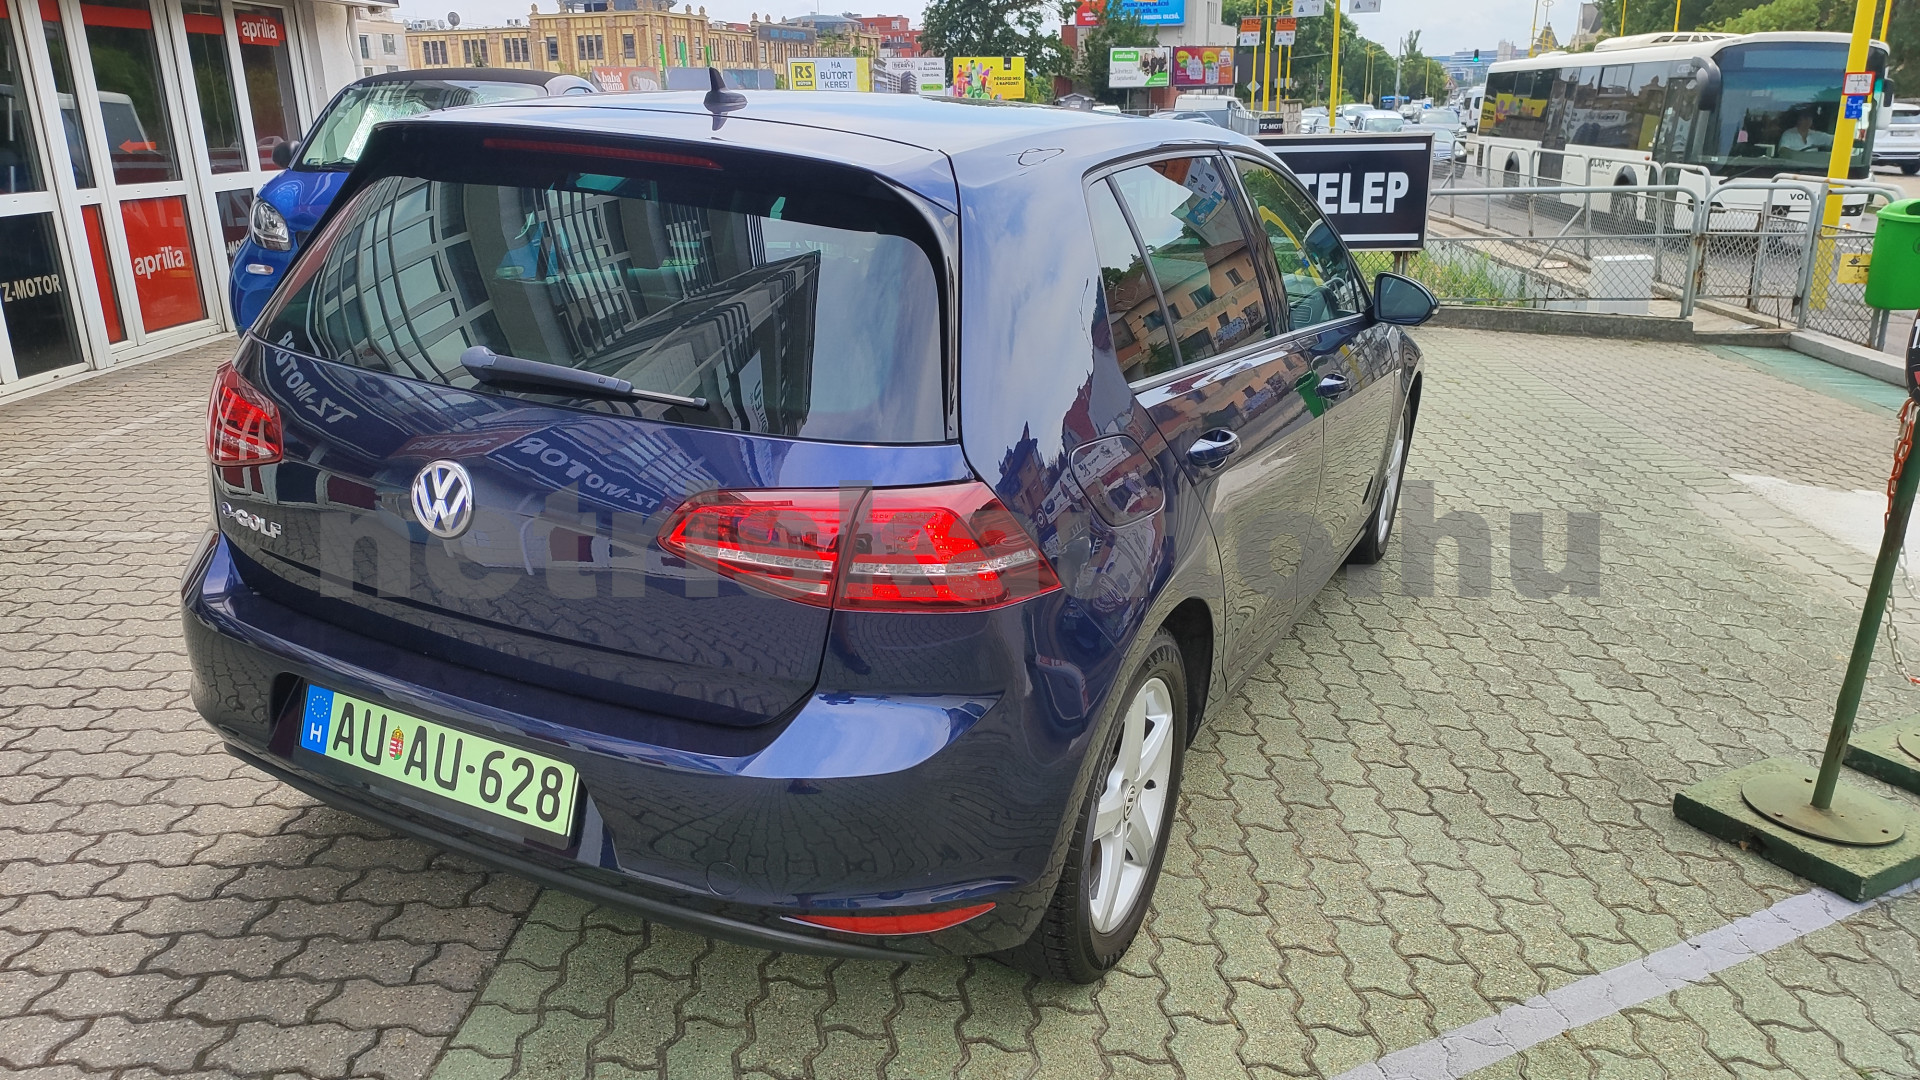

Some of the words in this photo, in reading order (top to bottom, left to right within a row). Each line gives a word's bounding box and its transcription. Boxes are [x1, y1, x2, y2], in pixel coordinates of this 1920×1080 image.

[241, 18, 278, 42] aprilia
[795, 65, 813, 79] RS
[820, 69, 854, 80] BÚTORT
[830, 61, 842, 69] HA
[1294, 171, 1409, 214] TELEP
[134, 245, 185, 280] aprilia
[0, 273, 62, 302] Z-MOTOR
[309, 722, 322, 743] H
[332, 701, 388, 766] AU
[404, 725, 564, 823] AU-628
